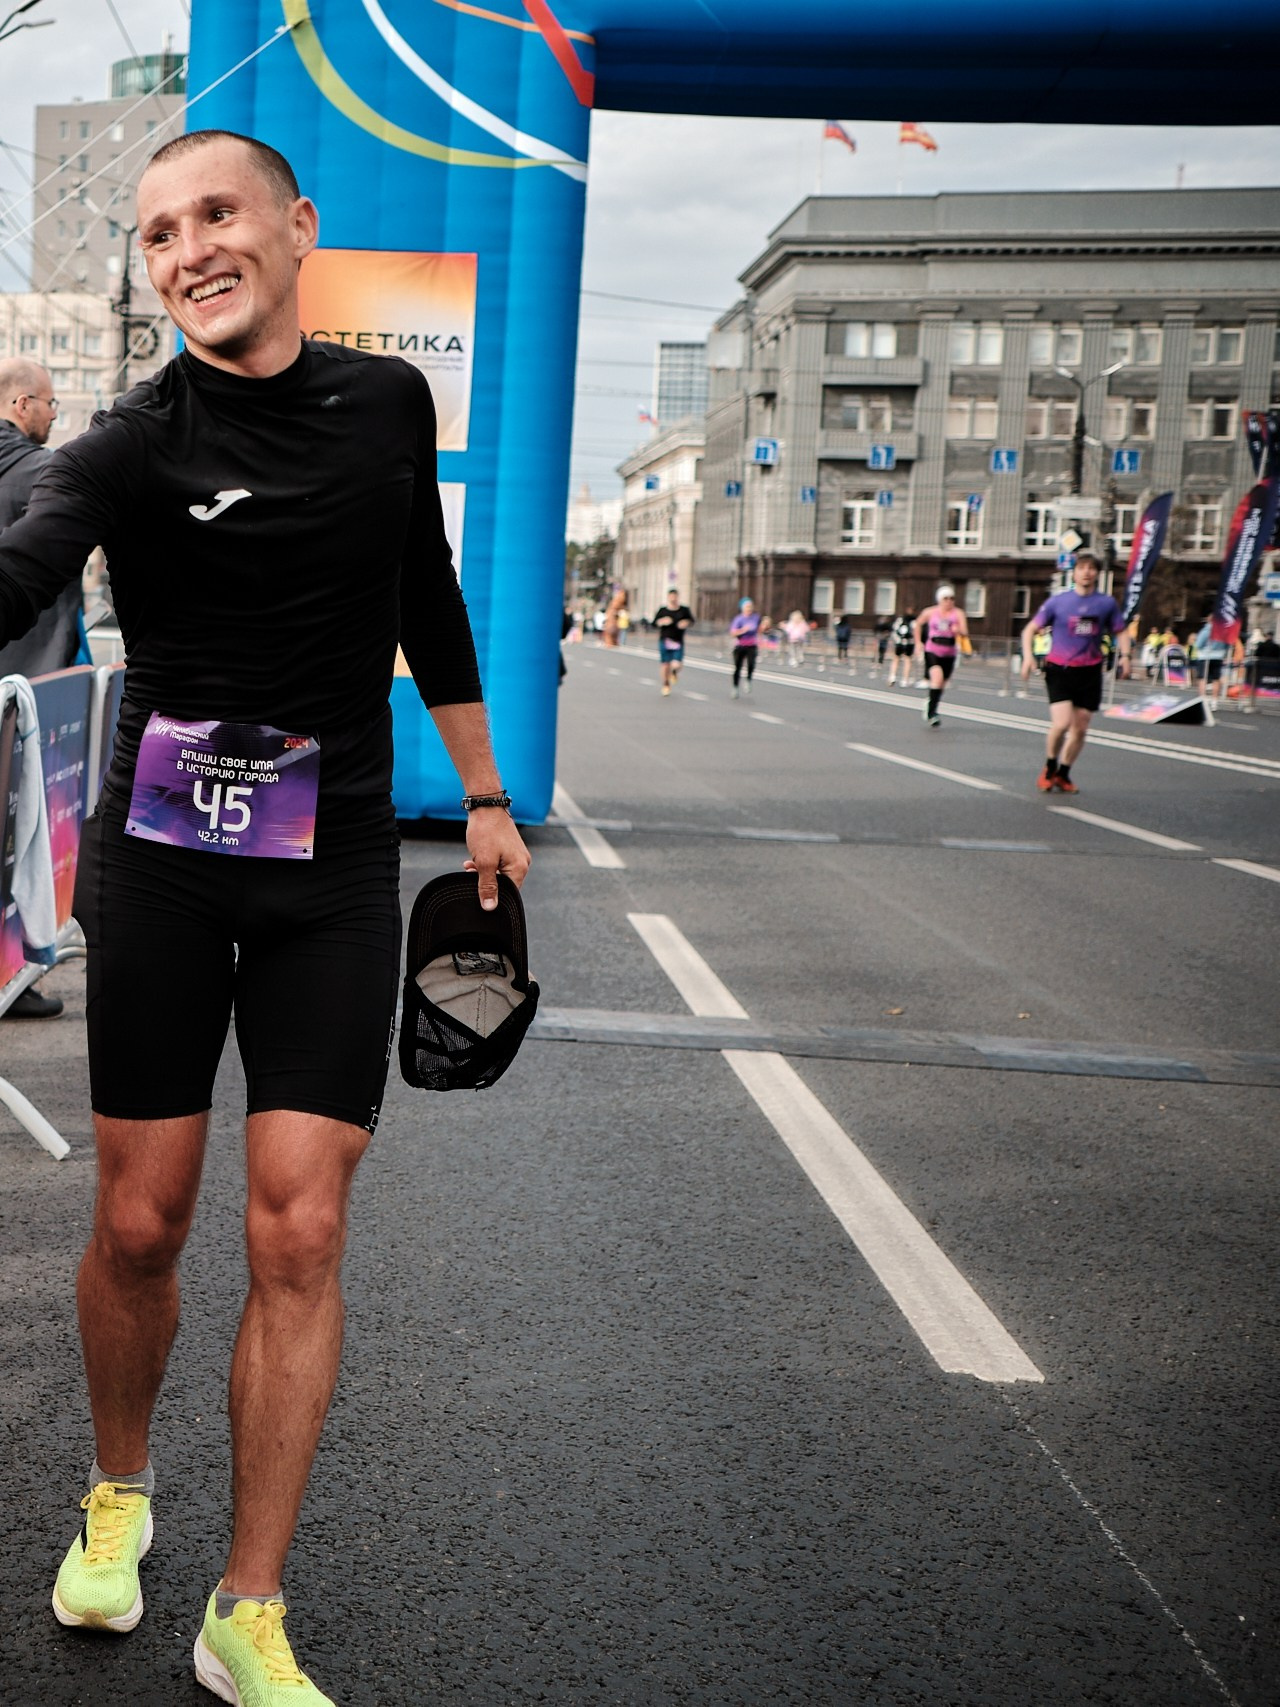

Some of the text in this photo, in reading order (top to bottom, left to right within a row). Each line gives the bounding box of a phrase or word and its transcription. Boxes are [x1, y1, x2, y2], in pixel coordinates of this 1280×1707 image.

[169, 731, 199, 745] Марафон
[283, 737, 310, 750] 2024
[180, 749, 275, 771] ВПИШИ СВОЕ ИМЯ
[176, 760, 280, 784] В ИСТОРИЮ ГОРОДА
[192, 780, 254, 833] 45
[197, 829, 220, 844] 42,2
